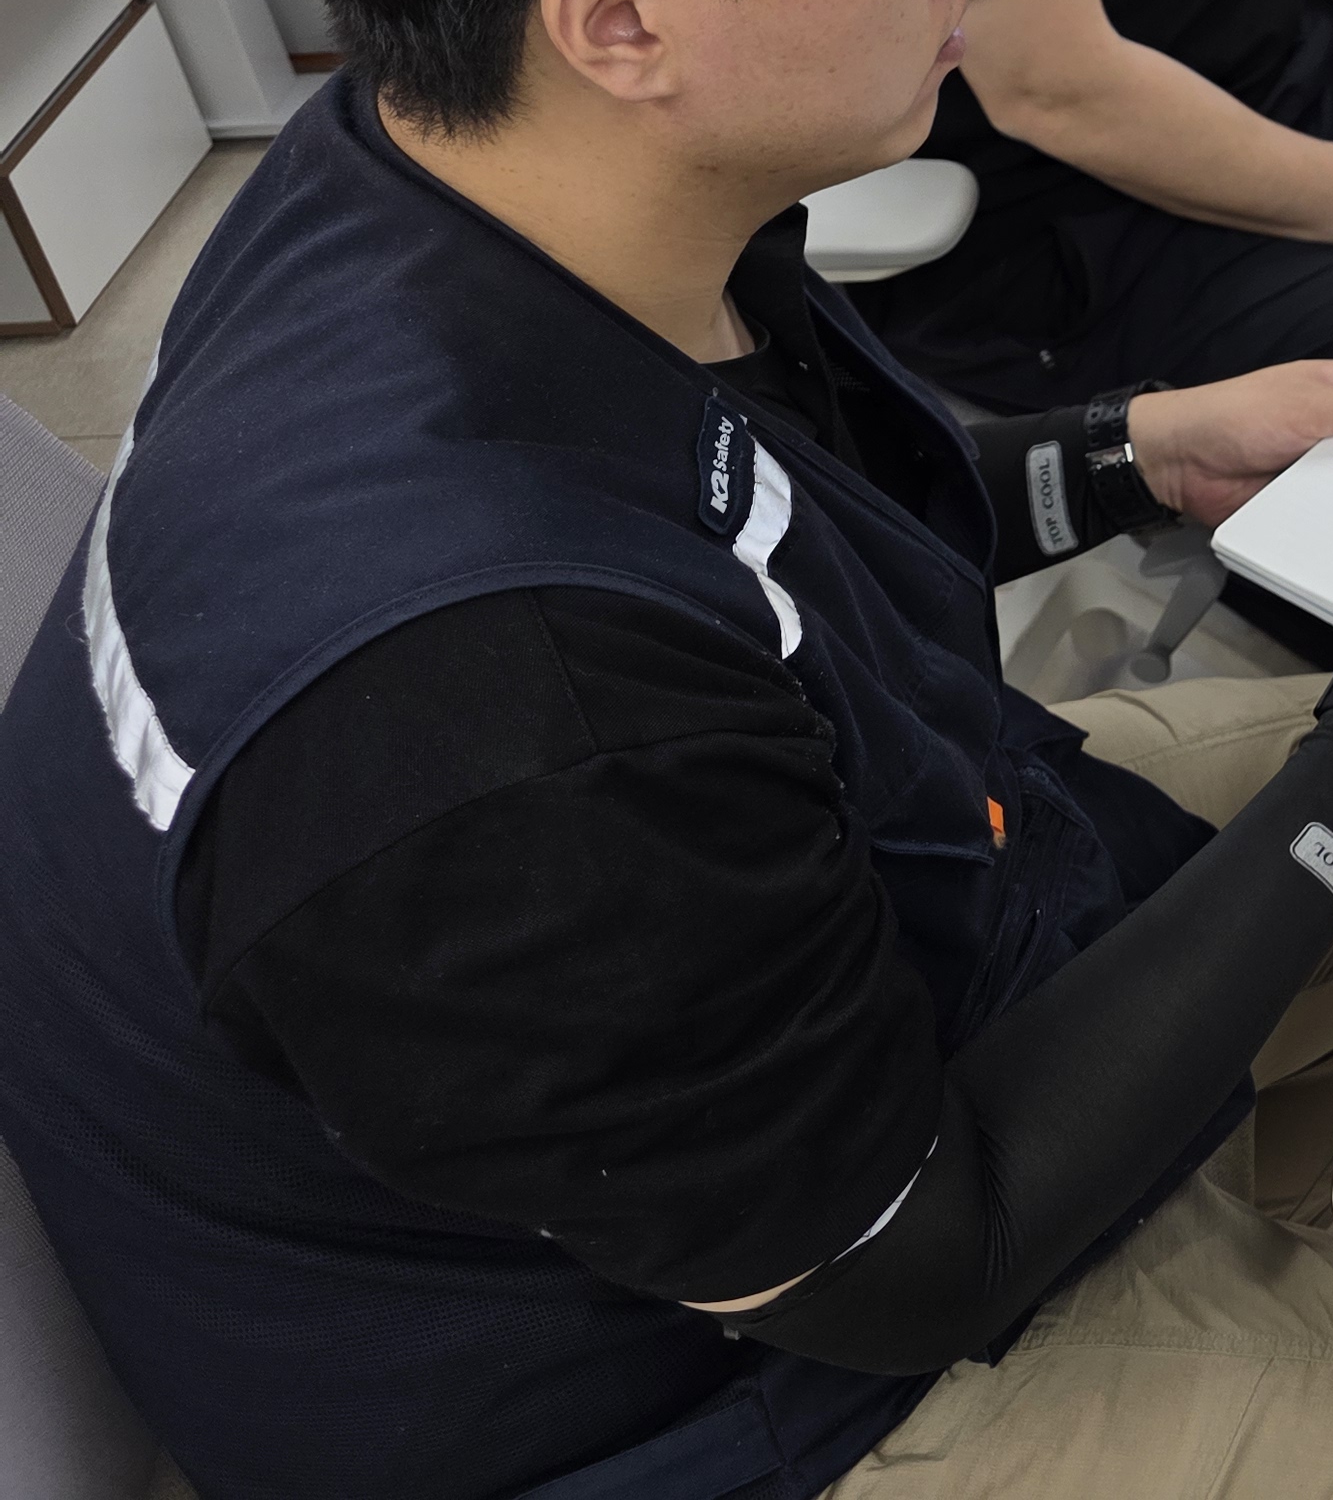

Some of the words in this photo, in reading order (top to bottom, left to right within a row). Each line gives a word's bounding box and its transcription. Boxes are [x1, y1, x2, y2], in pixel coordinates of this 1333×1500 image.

[712, 416, 735, 472] Safety
[710, 470, 730, 514] K2
[1038, 457, 1054, 509] COOL
[1045, 517, 1063, 546] TOP
